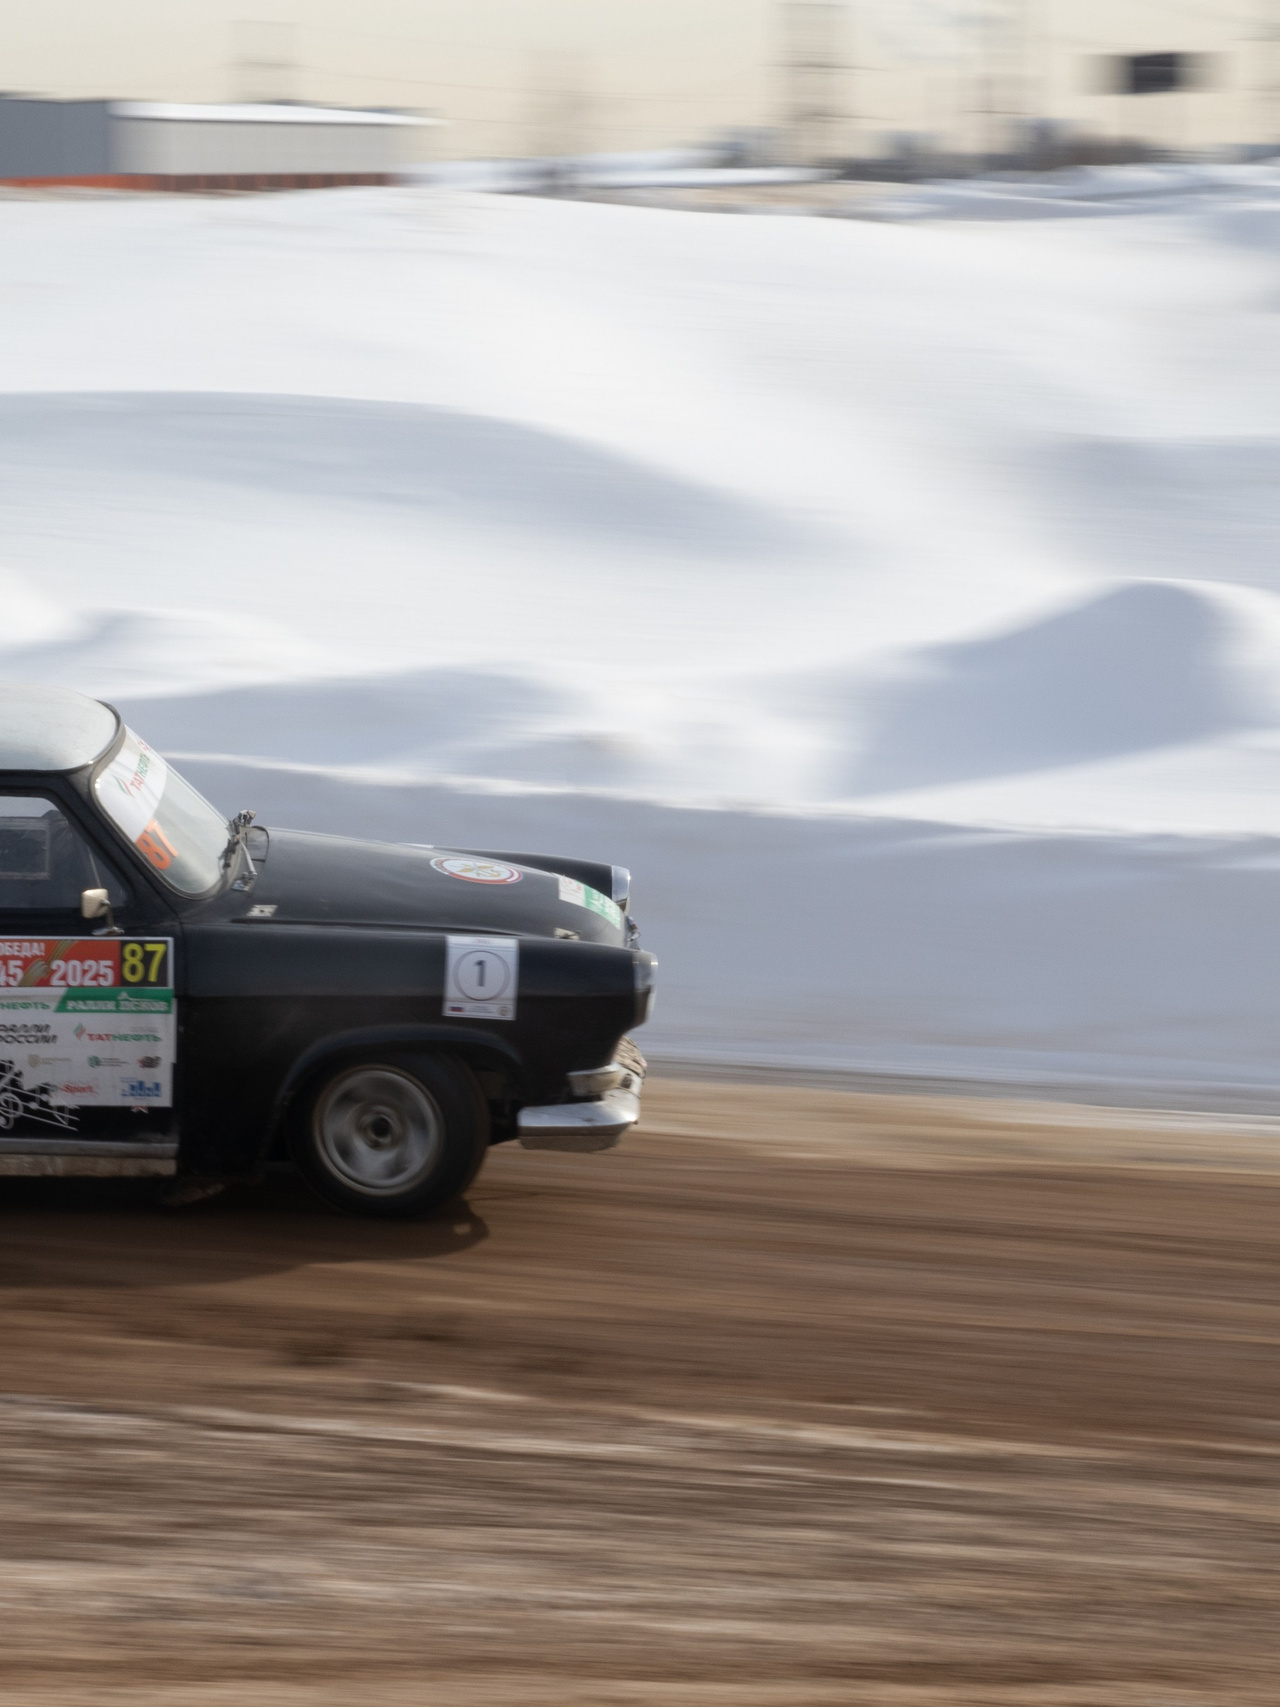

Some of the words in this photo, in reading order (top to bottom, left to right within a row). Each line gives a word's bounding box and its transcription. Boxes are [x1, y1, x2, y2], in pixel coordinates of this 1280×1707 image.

[135, 817, 179, 870] 87
[50, 960, 114, 986] 2025
[122, 943, 167, 982] 87
[474, 960, 487, 987] 1
[87, 1033, 162, 1042] ТАТНЕФТЬ
